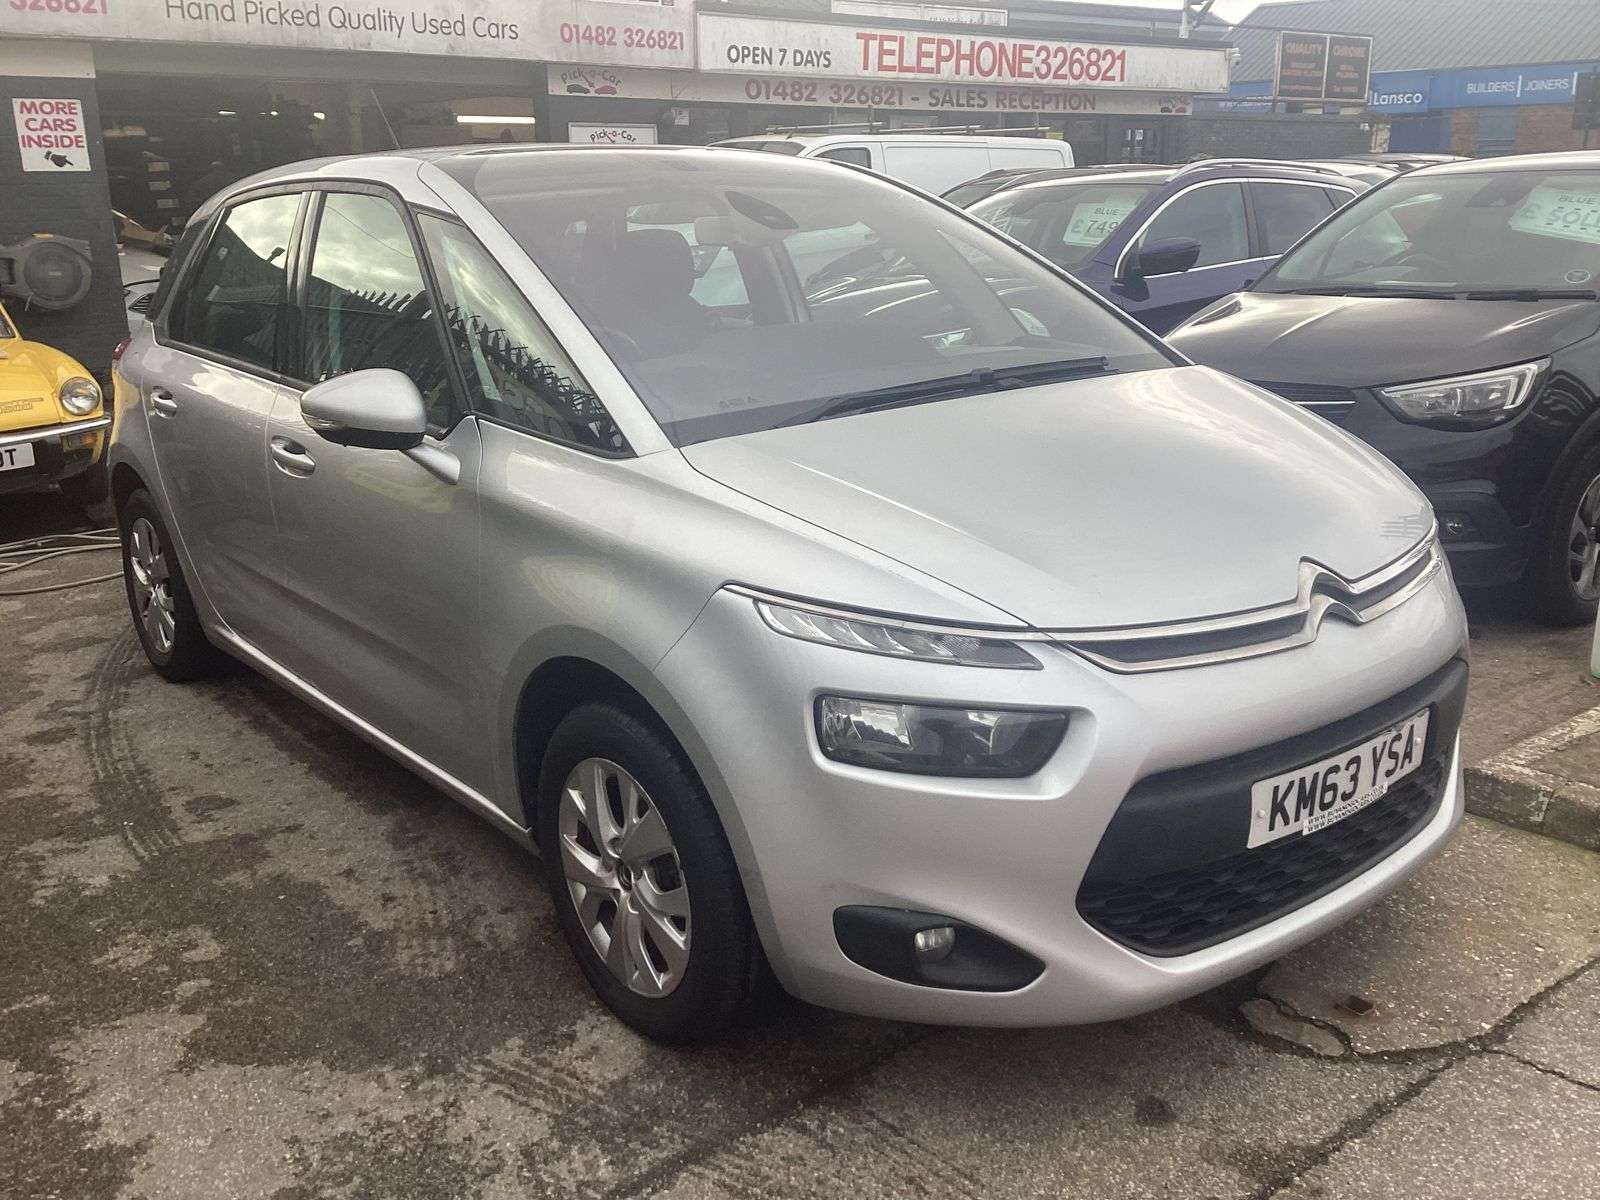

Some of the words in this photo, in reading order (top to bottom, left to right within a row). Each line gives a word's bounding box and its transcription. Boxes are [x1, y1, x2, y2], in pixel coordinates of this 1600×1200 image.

[165, 0, 236, 23] Hand
[245, 1, 321, 28] Picked
[328, 8, 404, 39] Quality
[411, 14, 466, 37] Used
[472, 17, 519, 40] Cars
[560, 23, 617, 47] 01482
[624, 27, 684, 51] 326821
[727, 44, 772, 66] OPEN
[779, 47, 787, 67] 7
[793, 49, 832, 69] DAYS
[561, 67, 622, 86] Pick-o-Car
[1466, 80, 1516, 94] BUILDERS
[1524, 78, 1570, 92] JOINERS
[745, 79, 818, 102] 01482
[828, 83, 904, 106] 326821
[928, 87, 988, 109] SALES
[995, 90, 1097, 111] RECEPTION
[1373, 91, 1423, 106] Lansco
[19, 101, 78, 116] MORE
[25, 118, 77, 132] CARS
[20, 134, 86, 149] INSIDE
[590, 128, 637, 143] Pick-o-Car
[1558, 192, 1598, 205] BLUE
[1094, 206, 1120, 216] BLUE
[1268, 754, 1362, 832] KM63
[1371, 723, 1415, 788] YSA
